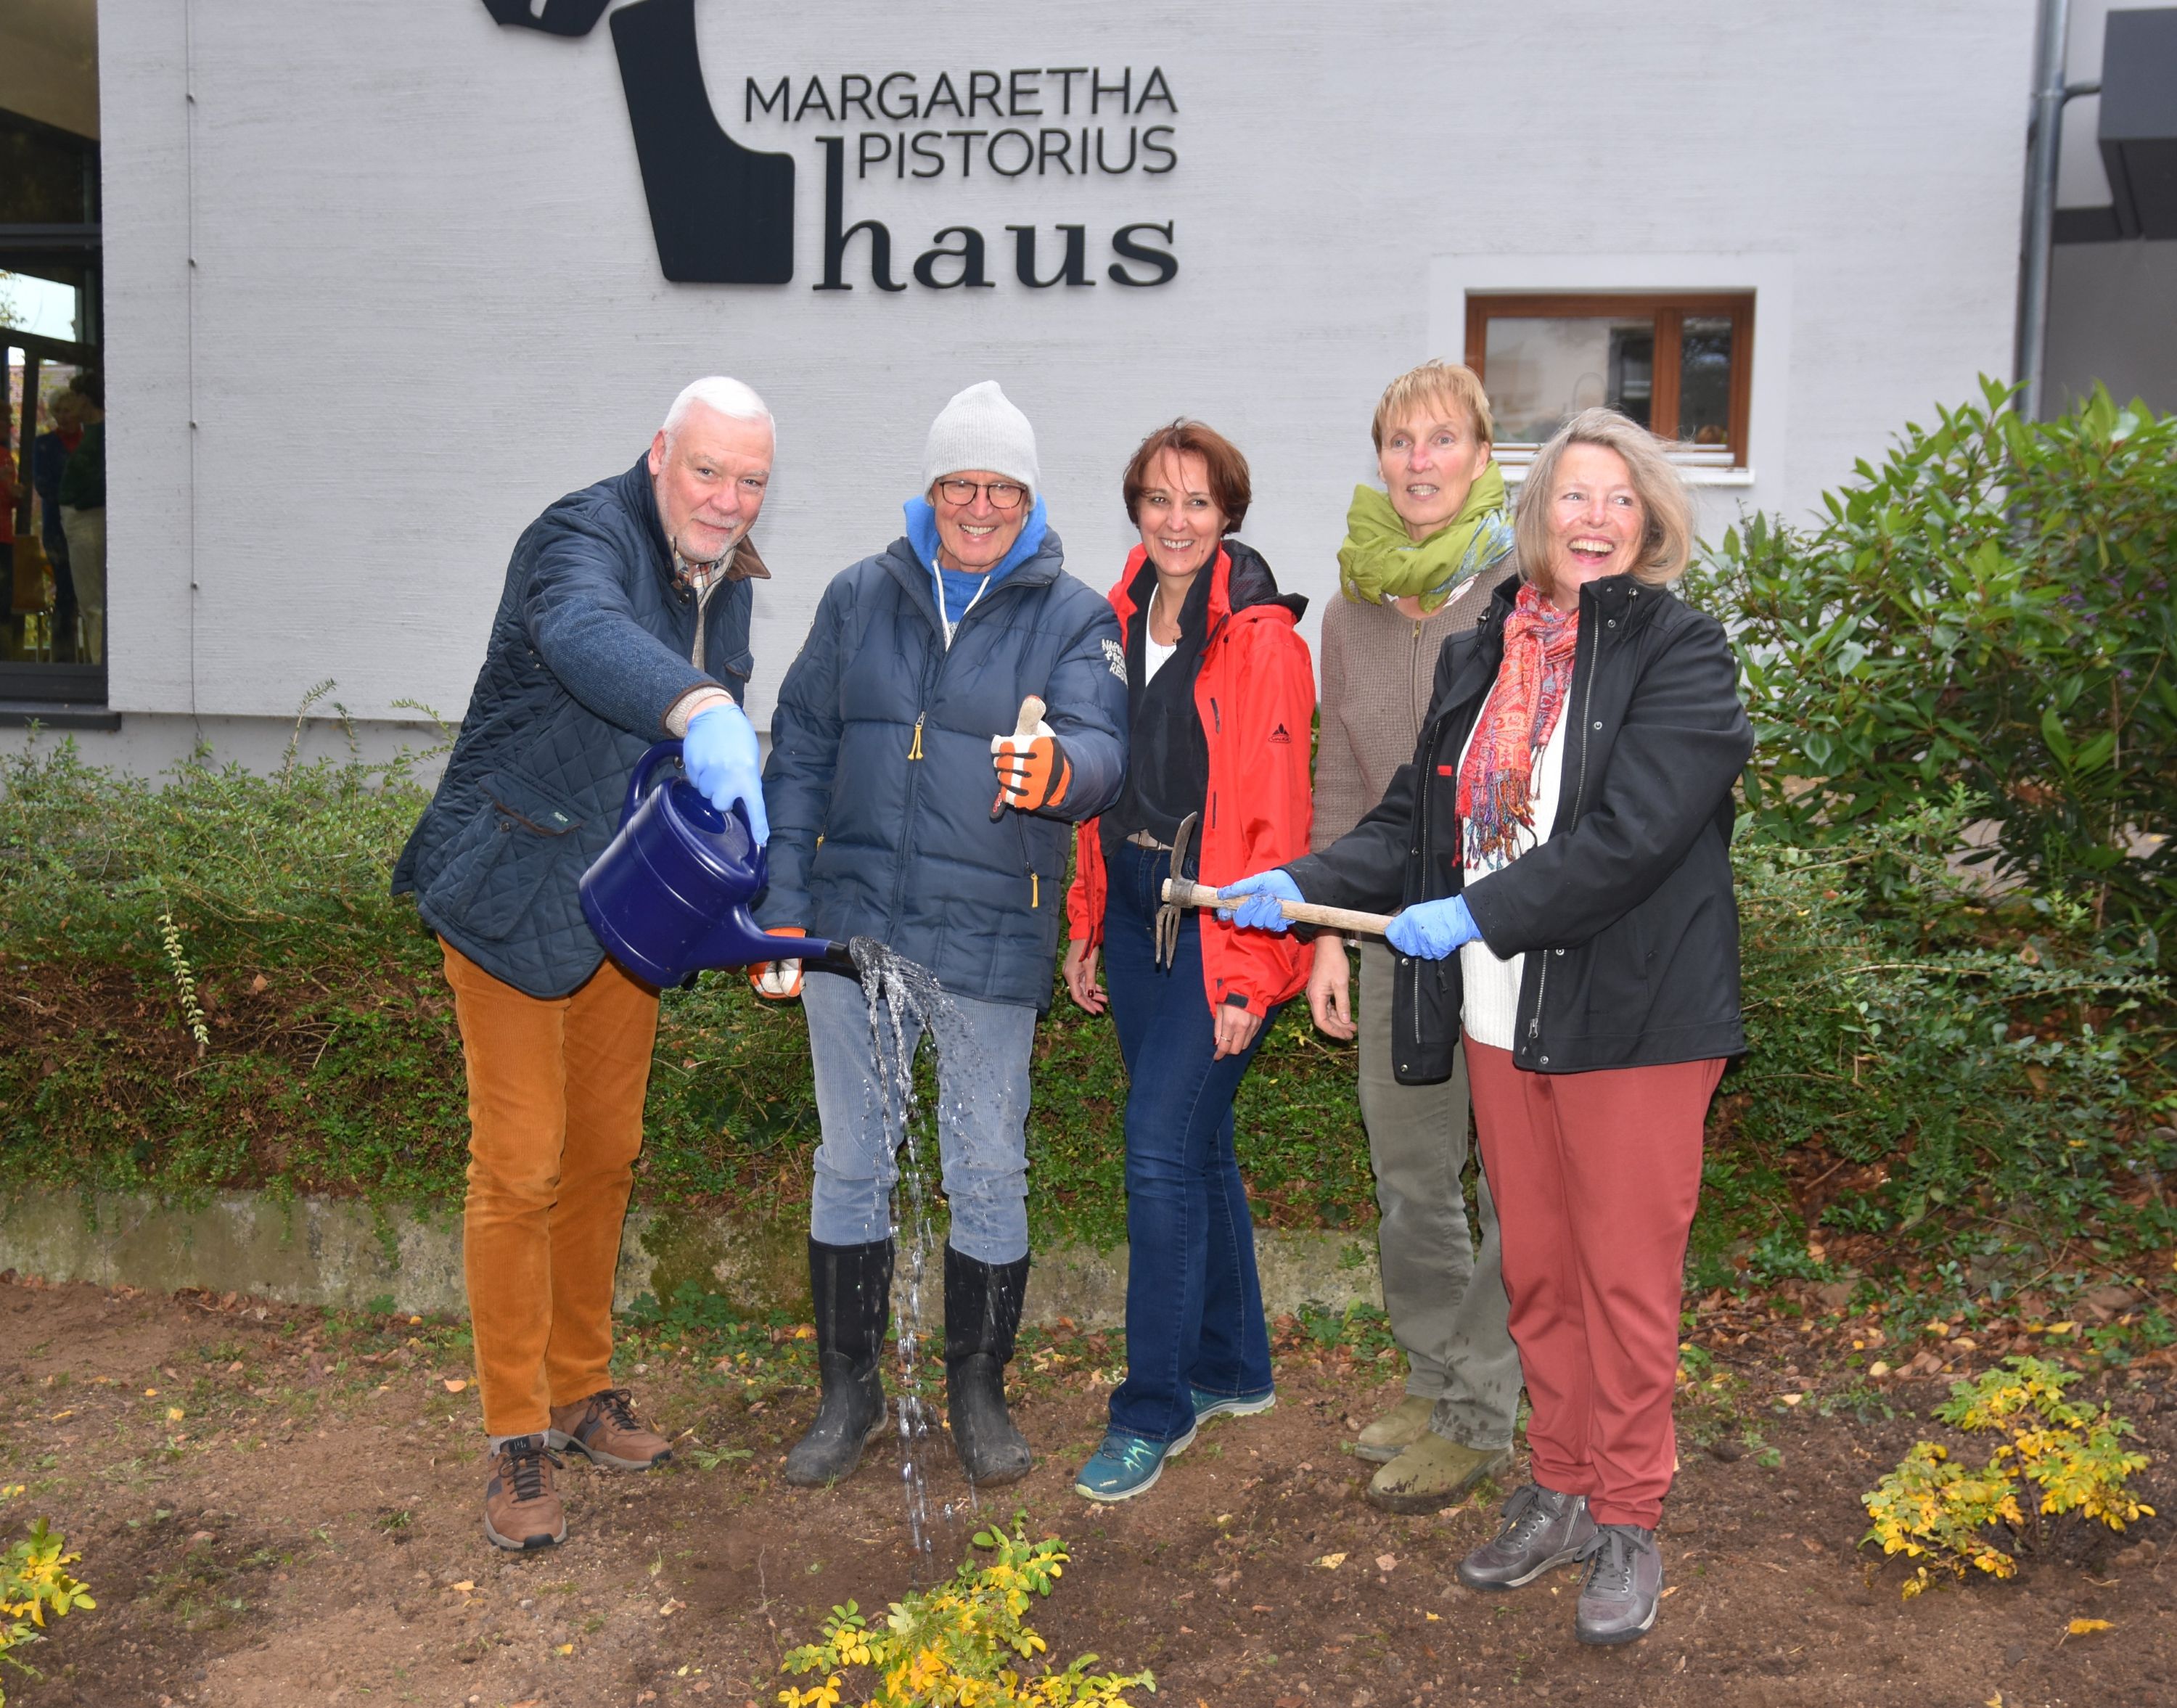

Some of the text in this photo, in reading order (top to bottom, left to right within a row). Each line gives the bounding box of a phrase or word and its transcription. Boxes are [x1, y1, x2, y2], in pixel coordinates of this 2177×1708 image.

[745, 67, 1178, 122] MARGARETHA
[859, 126, 1178, 178] PISTORIUS
[813, 136, 1178, 292] haus
